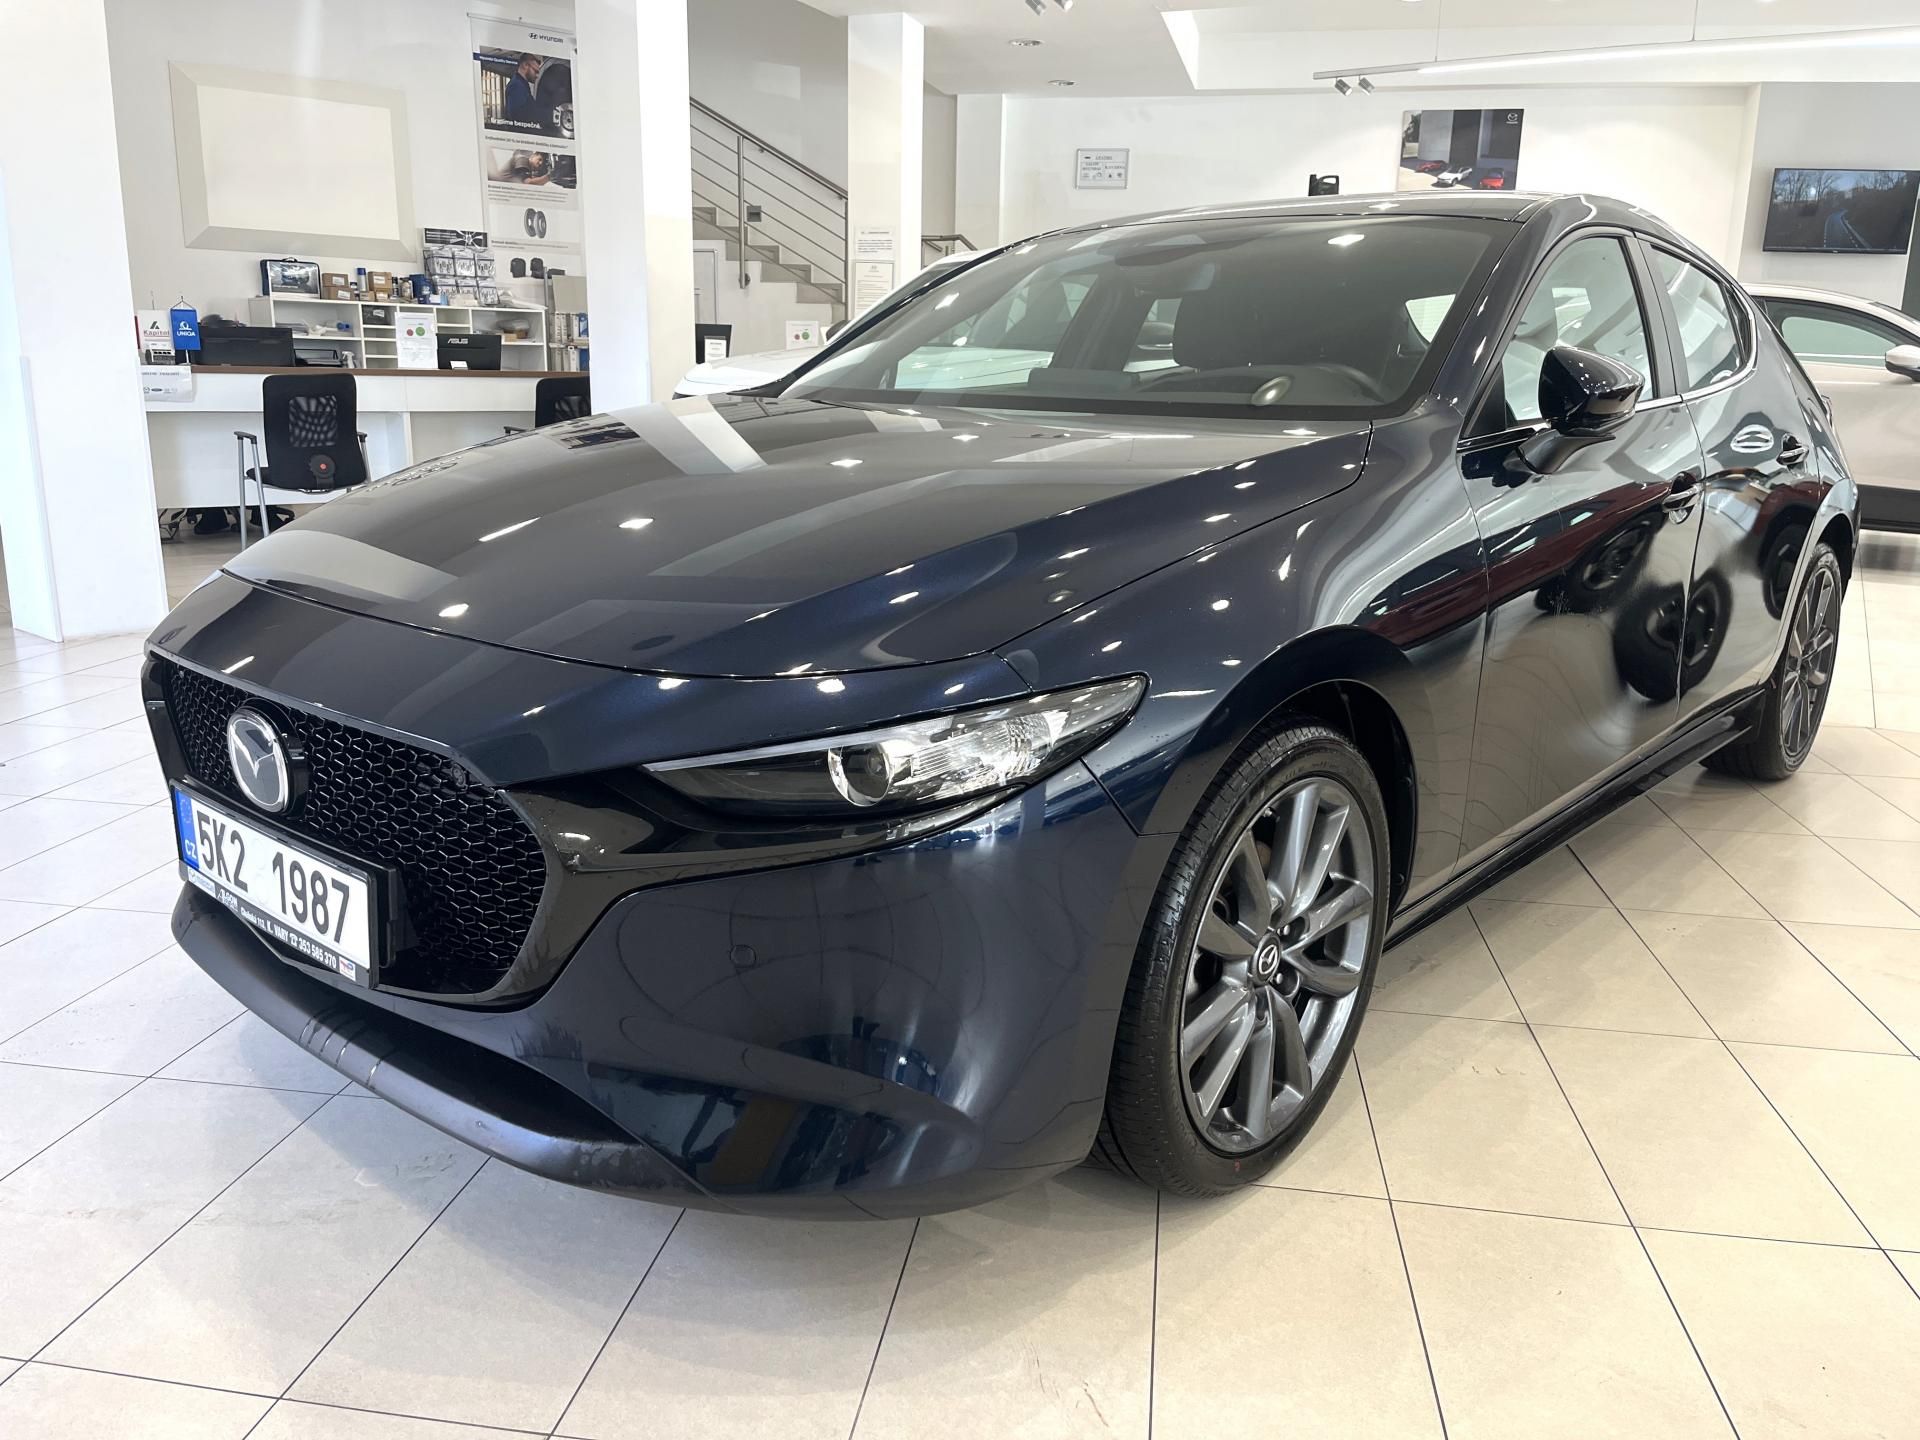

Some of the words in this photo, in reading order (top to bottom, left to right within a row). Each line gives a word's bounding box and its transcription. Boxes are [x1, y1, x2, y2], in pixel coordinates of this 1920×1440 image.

[185, 842, 197, 859] CZ
[197, 810, 248, 893] 5K2
[272, 851, 350, 943] 1987
[324, 951, 337, 969] 370
